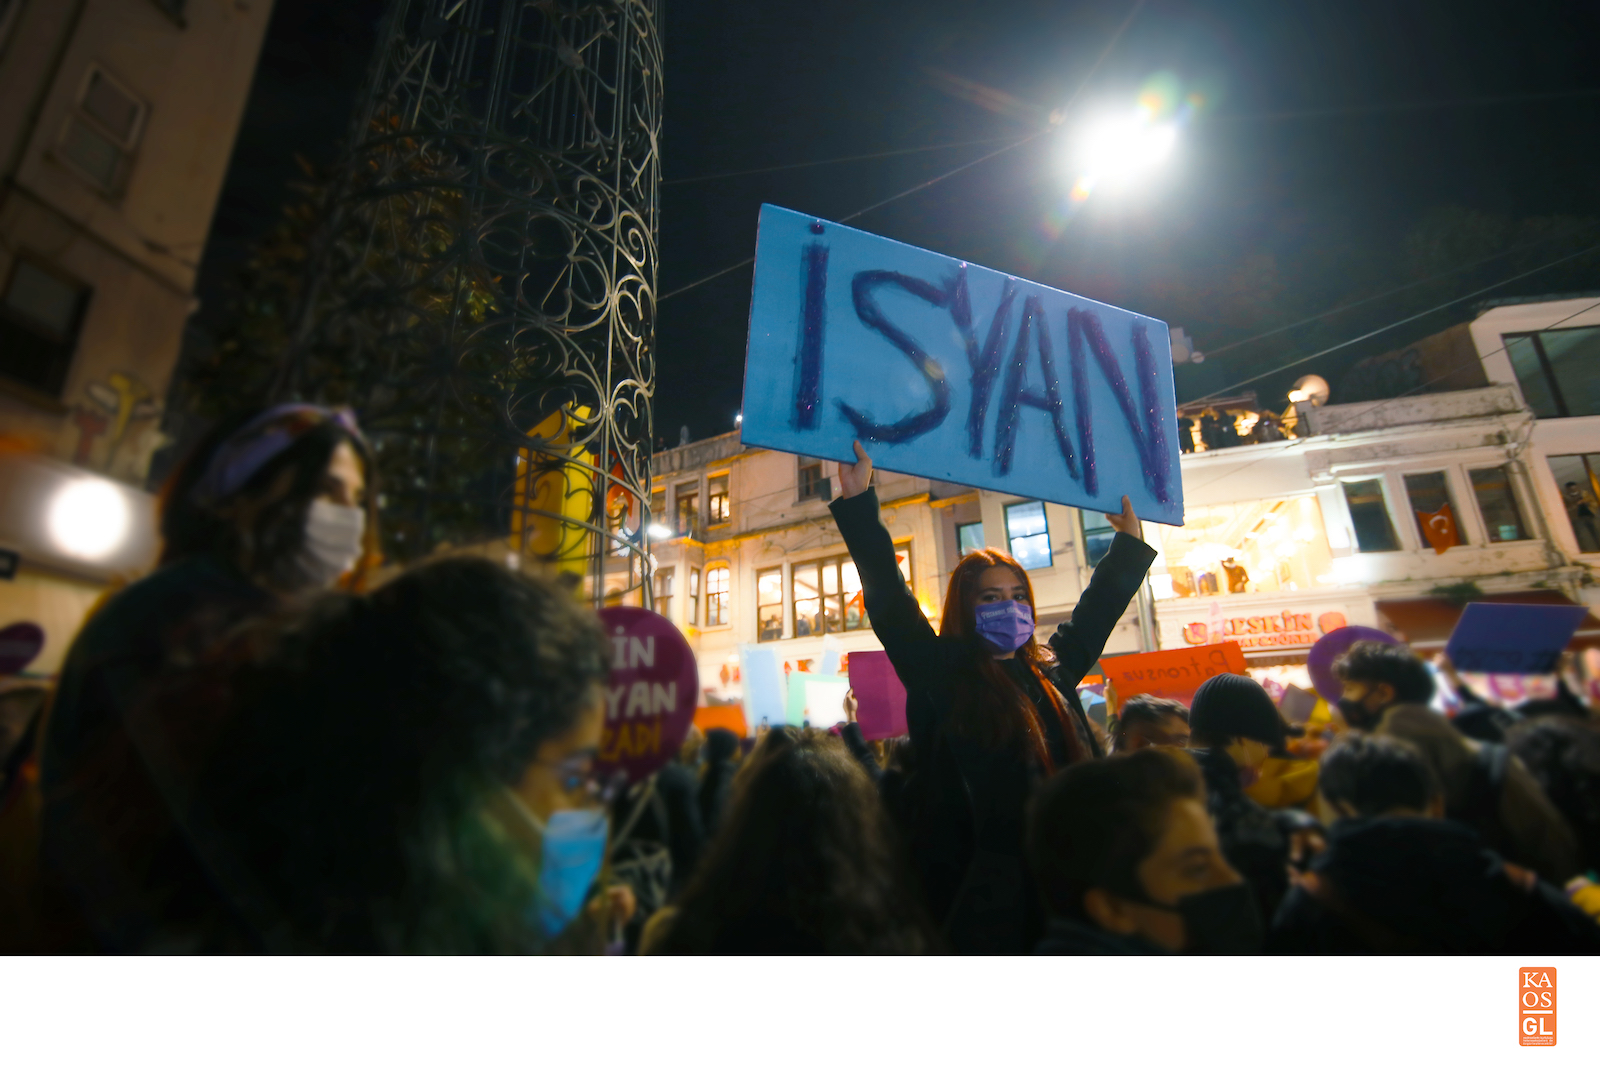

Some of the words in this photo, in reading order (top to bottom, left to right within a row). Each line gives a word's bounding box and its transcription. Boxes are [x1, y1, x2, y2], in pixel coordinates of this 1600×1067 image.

[790, 220, 1171, 505] İSYAN
[612, 626, 655, 669] İN
[605, 681, 677, 720] YAN
